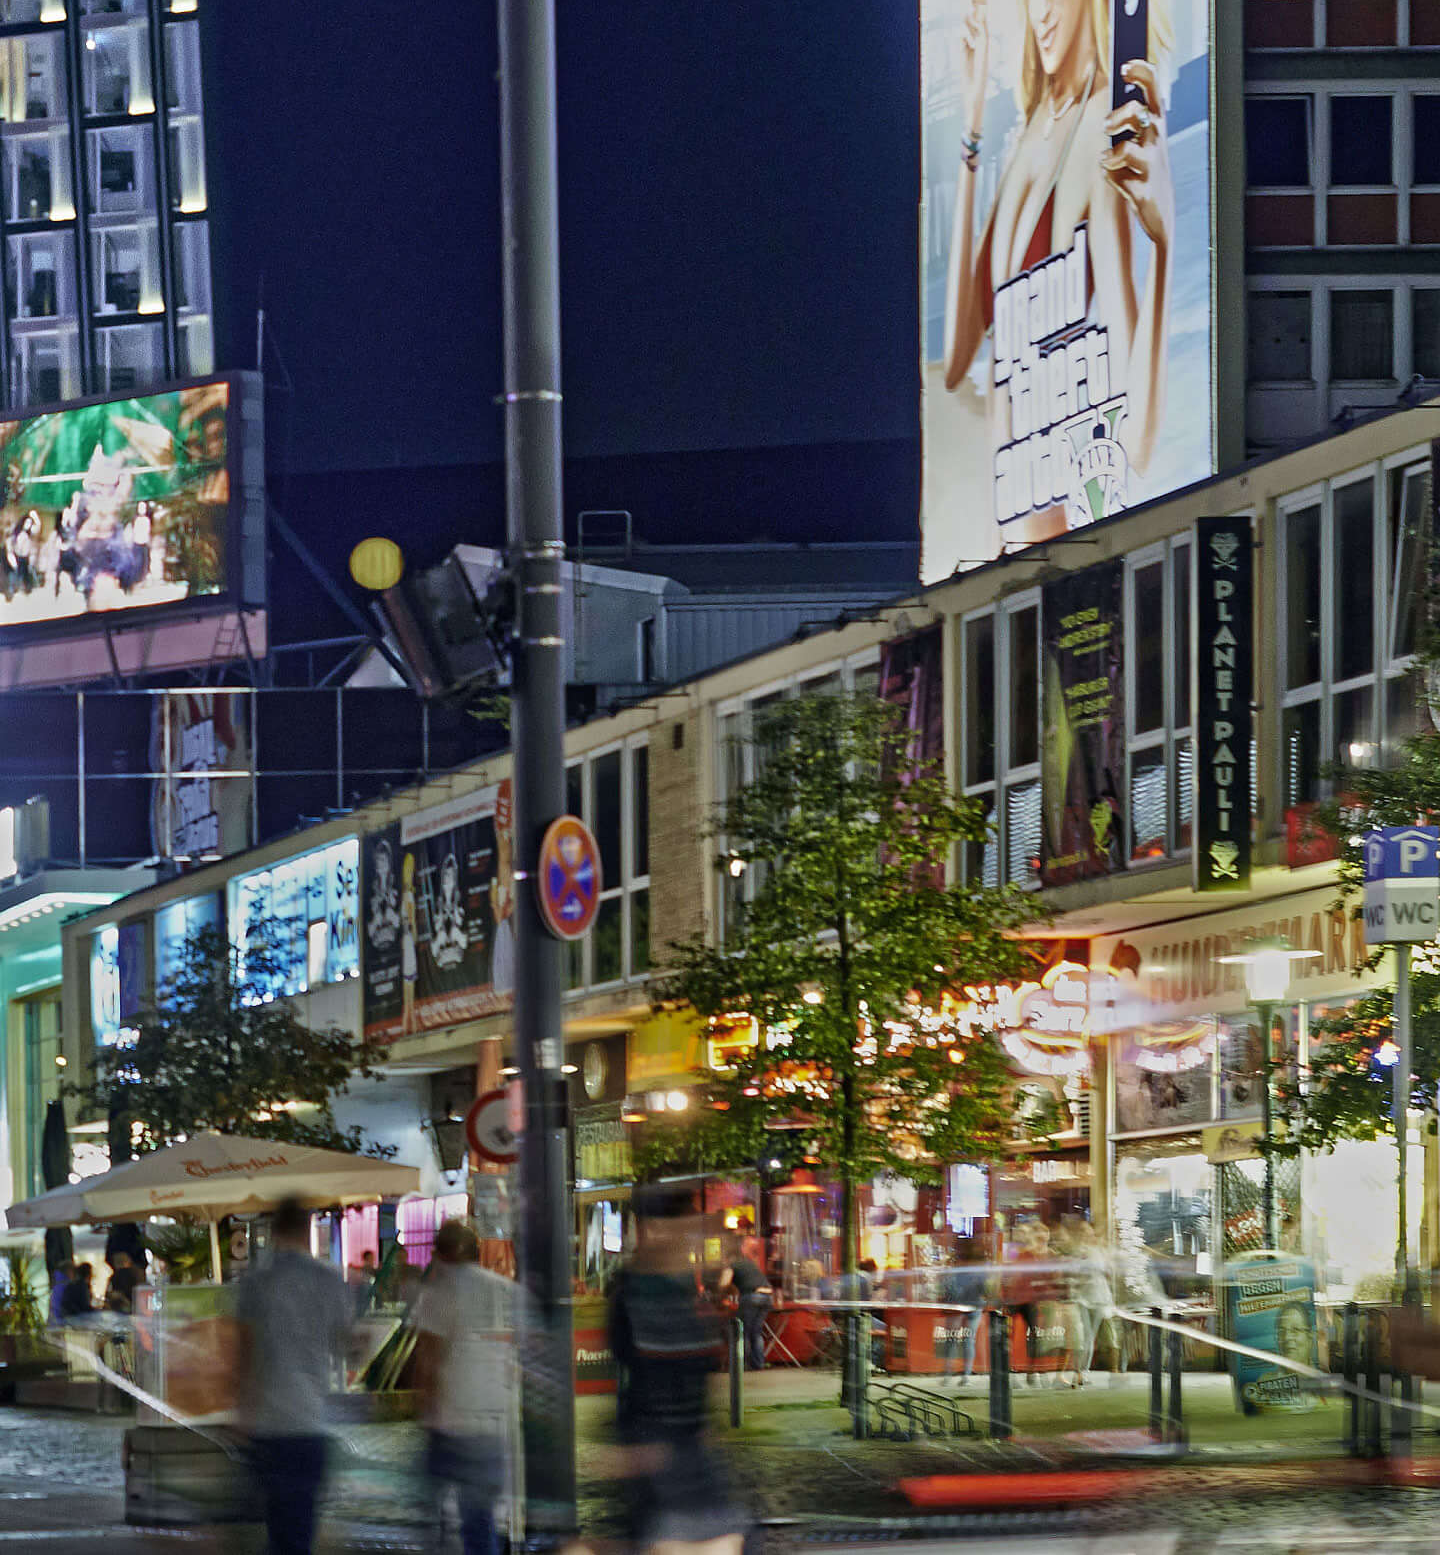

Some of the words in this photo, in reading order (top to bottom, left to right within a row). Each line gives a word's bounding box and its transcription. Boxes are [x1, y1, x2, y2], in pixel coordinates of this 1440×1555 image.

[1213, 579, 1237, 712] PLANET
[1213, 720, 1237, 832] PAULI
[1399, 839, 1428, 874] P
[1364, 904, 1384, 929] WC
[1391, 901, 1435, 924] WC
[1150, 905, 1368, 1004] HUNDMARK
